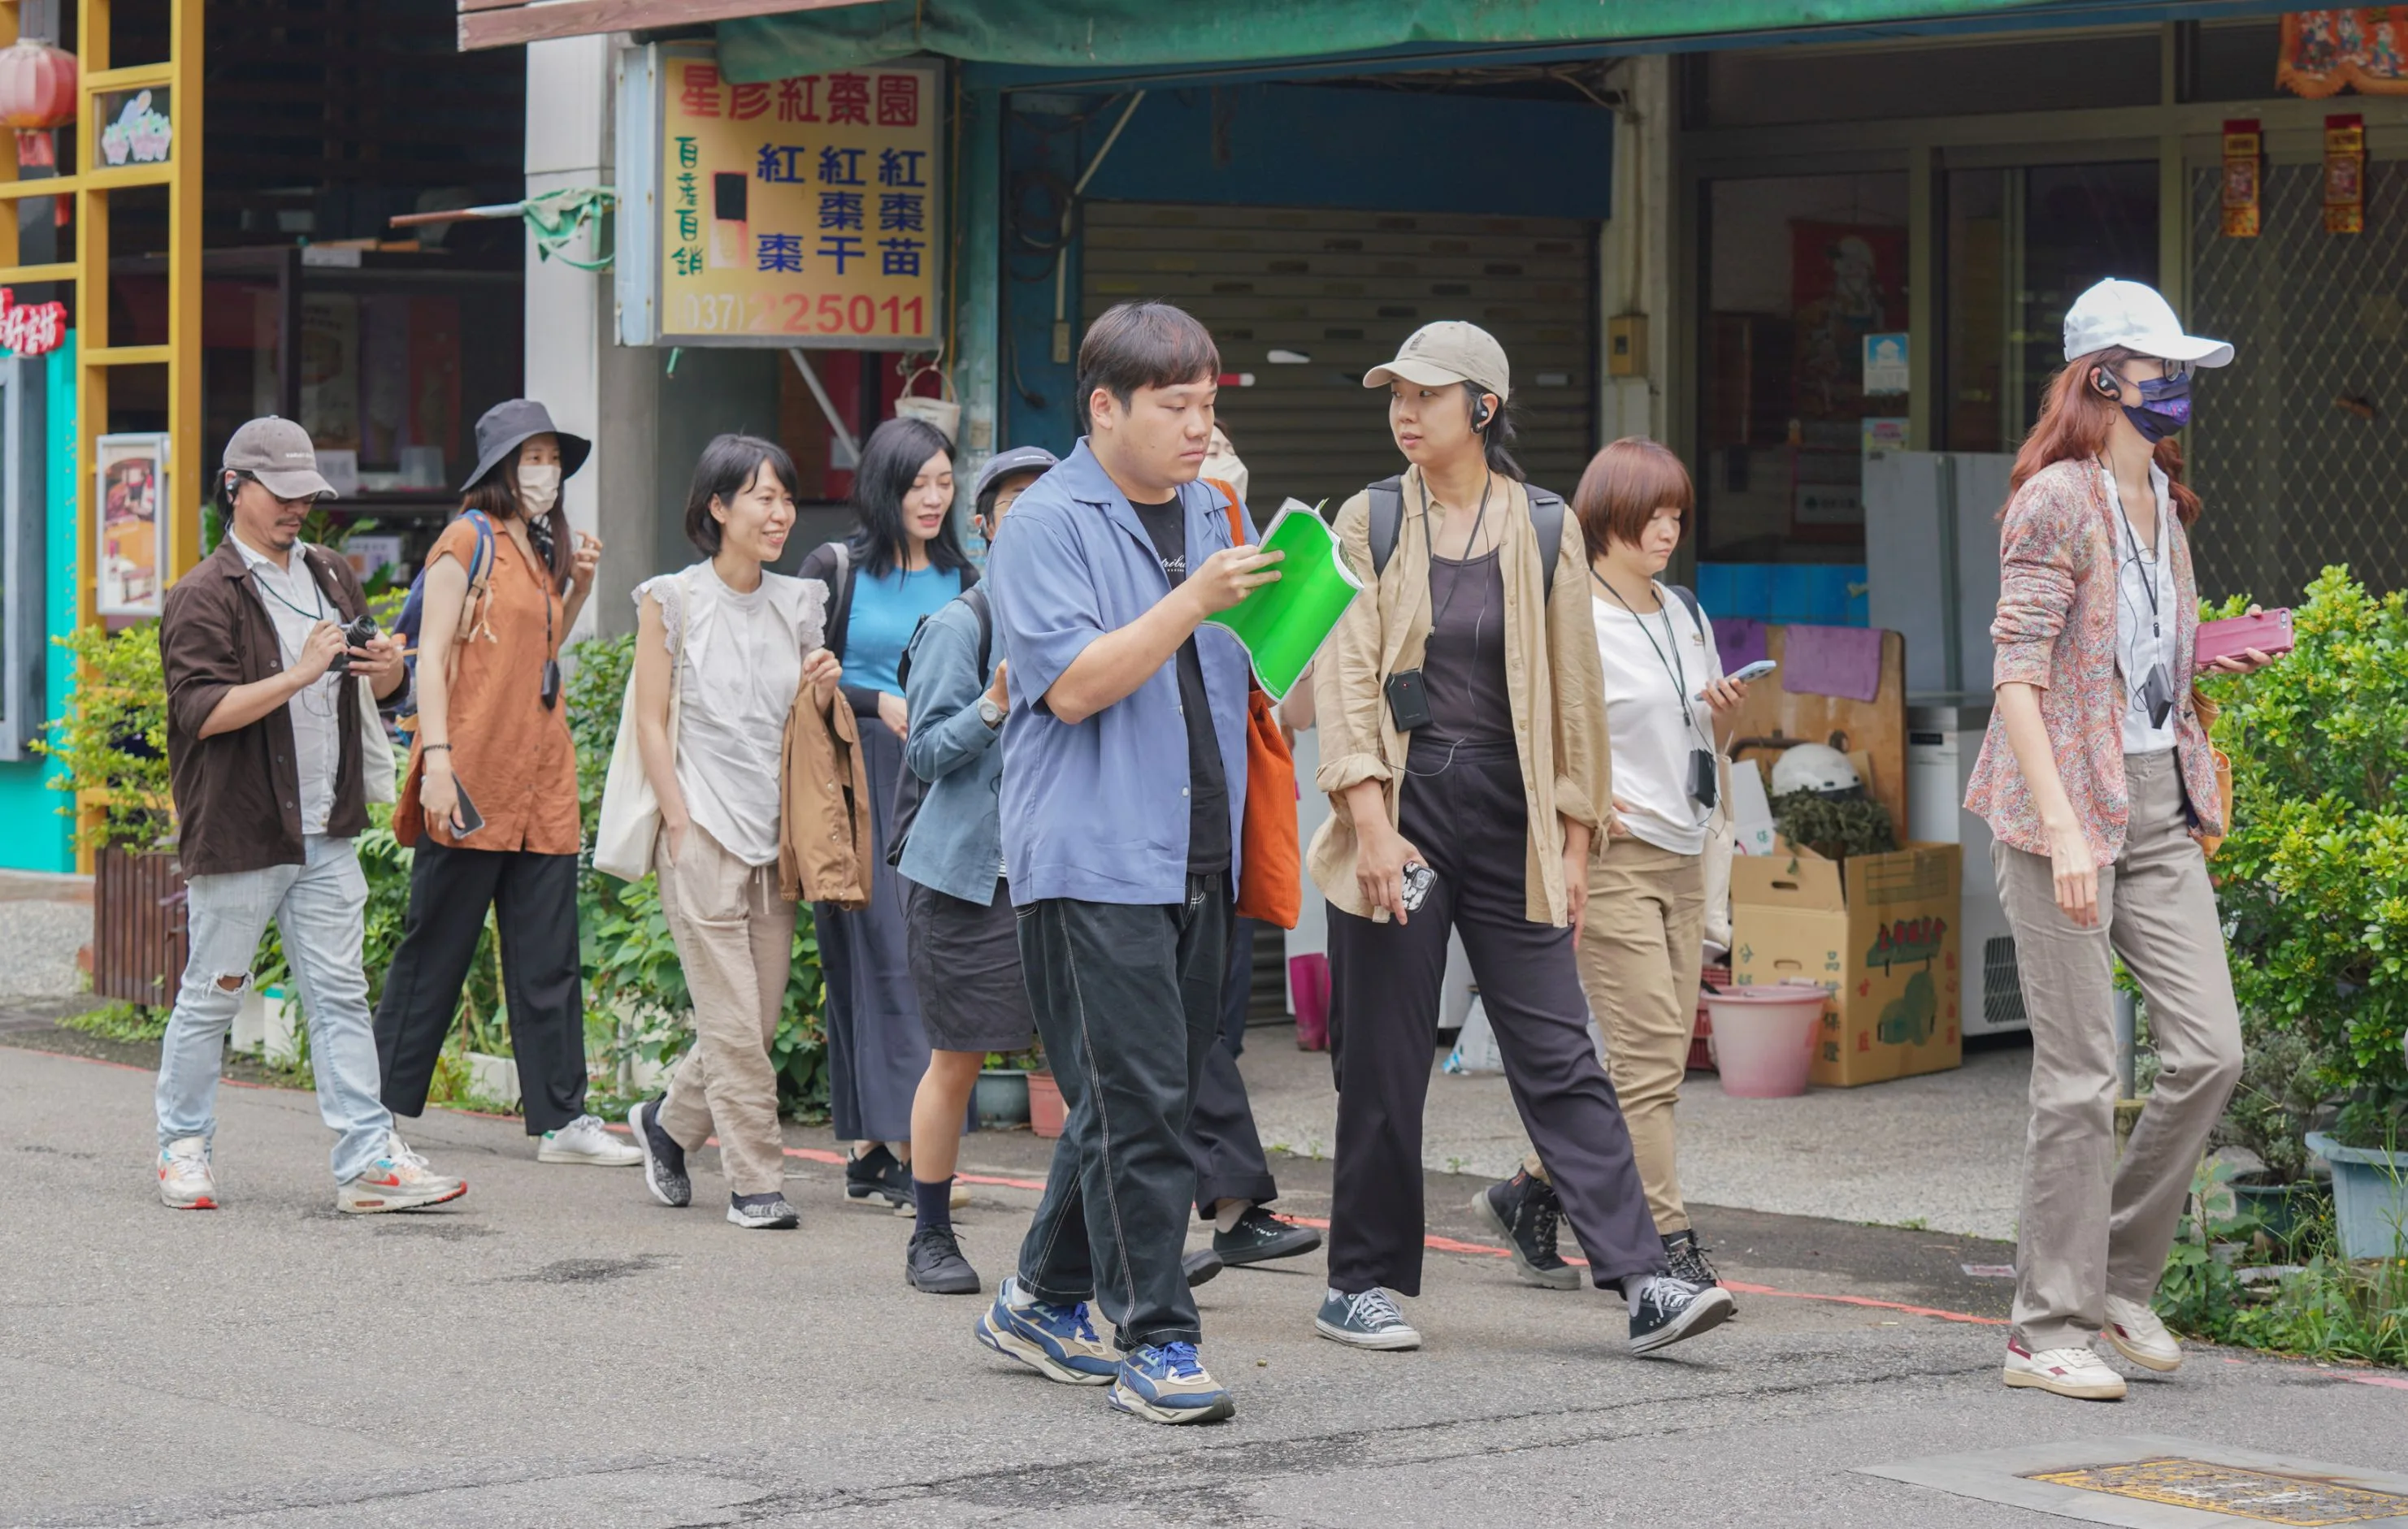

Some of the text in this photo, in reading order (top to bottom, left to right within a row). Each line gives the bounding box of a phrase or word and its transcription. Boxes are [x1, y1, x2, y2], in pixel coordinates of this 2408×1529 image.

[817, 145, 866, 275] 紅棗干
[878, 147, 926, 277] 紅棗苗
